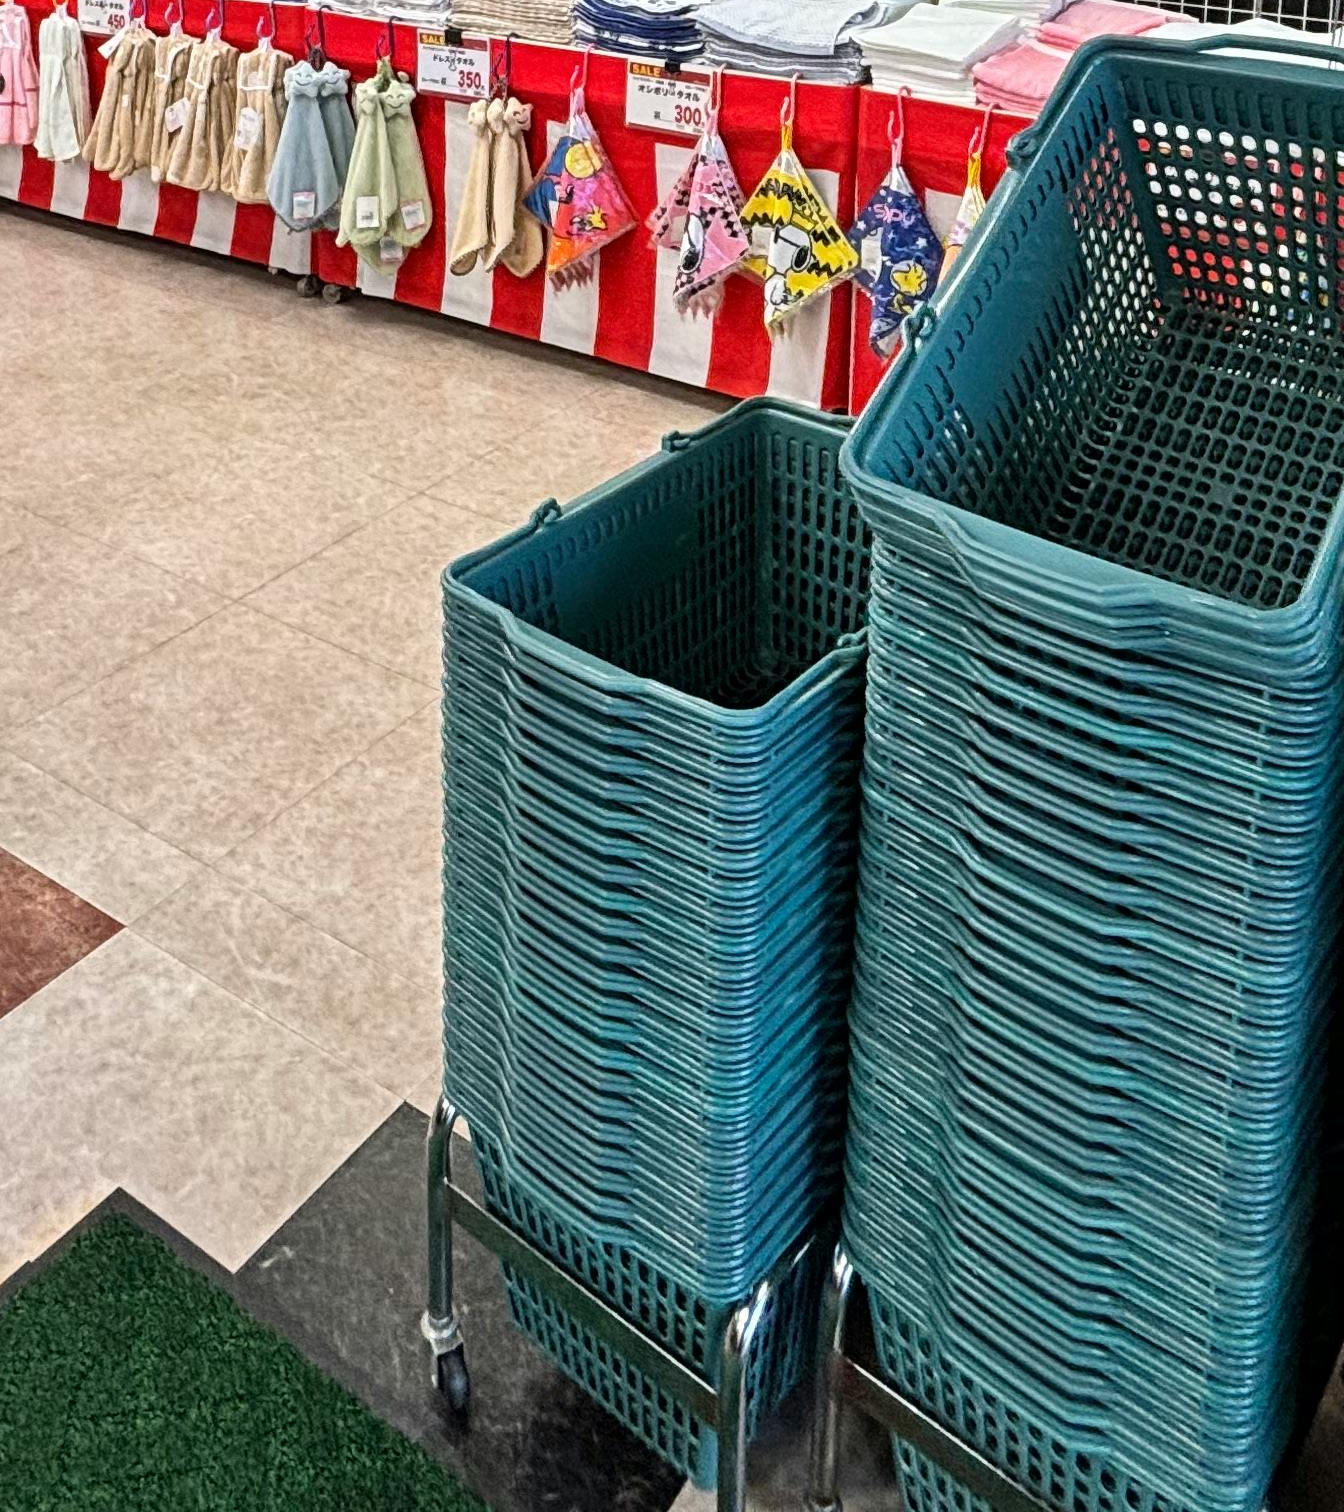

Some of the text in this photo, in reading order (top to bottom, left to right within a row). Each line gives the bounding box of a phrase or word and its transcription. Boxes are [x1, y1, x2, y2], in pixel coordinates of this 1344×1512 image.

[107, 13, 126, 28] 450
[632, 62, 662, 76] SALE
[457, 71, 481, 88] 350
[674, 104, 702, 125] 300
